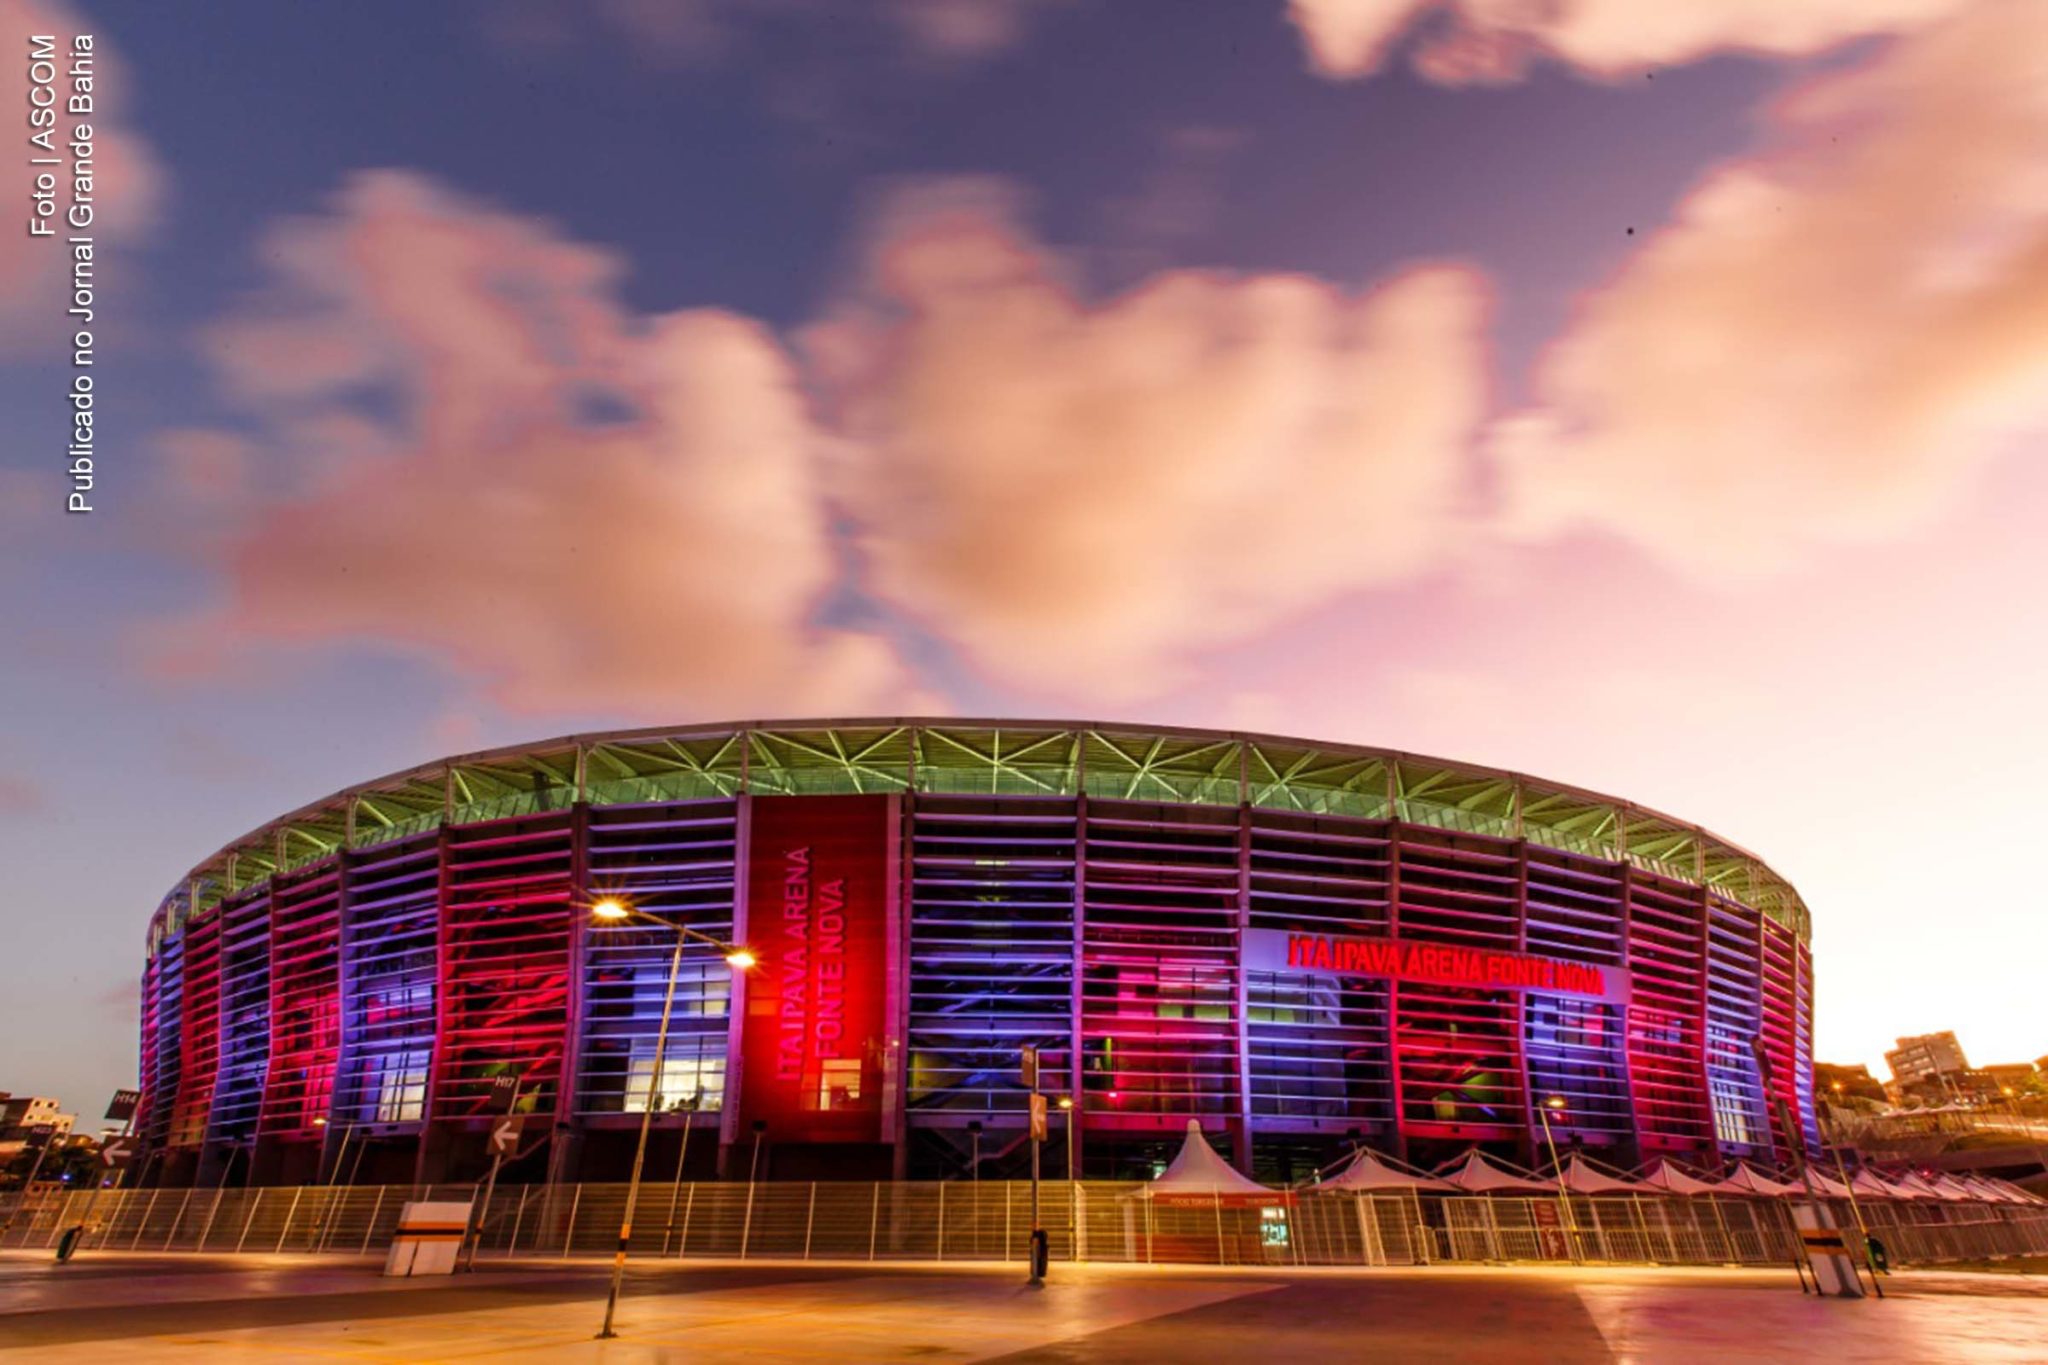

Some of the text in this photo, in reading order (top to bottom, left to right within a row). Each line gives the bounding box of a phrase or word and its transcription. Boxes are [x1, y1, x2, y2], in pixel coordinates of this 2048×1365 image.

[777, 847, 810, 1080] ITAIPAVA ARENA
[815, 878, 844, 1059] FONTE NOVA
[1287, 935, 1606, 996] ITAIPAVA ARENA FONTE NOVA
[114, 1093, 137, 1104] H14
[495, 1075, 515, 1087] H17
